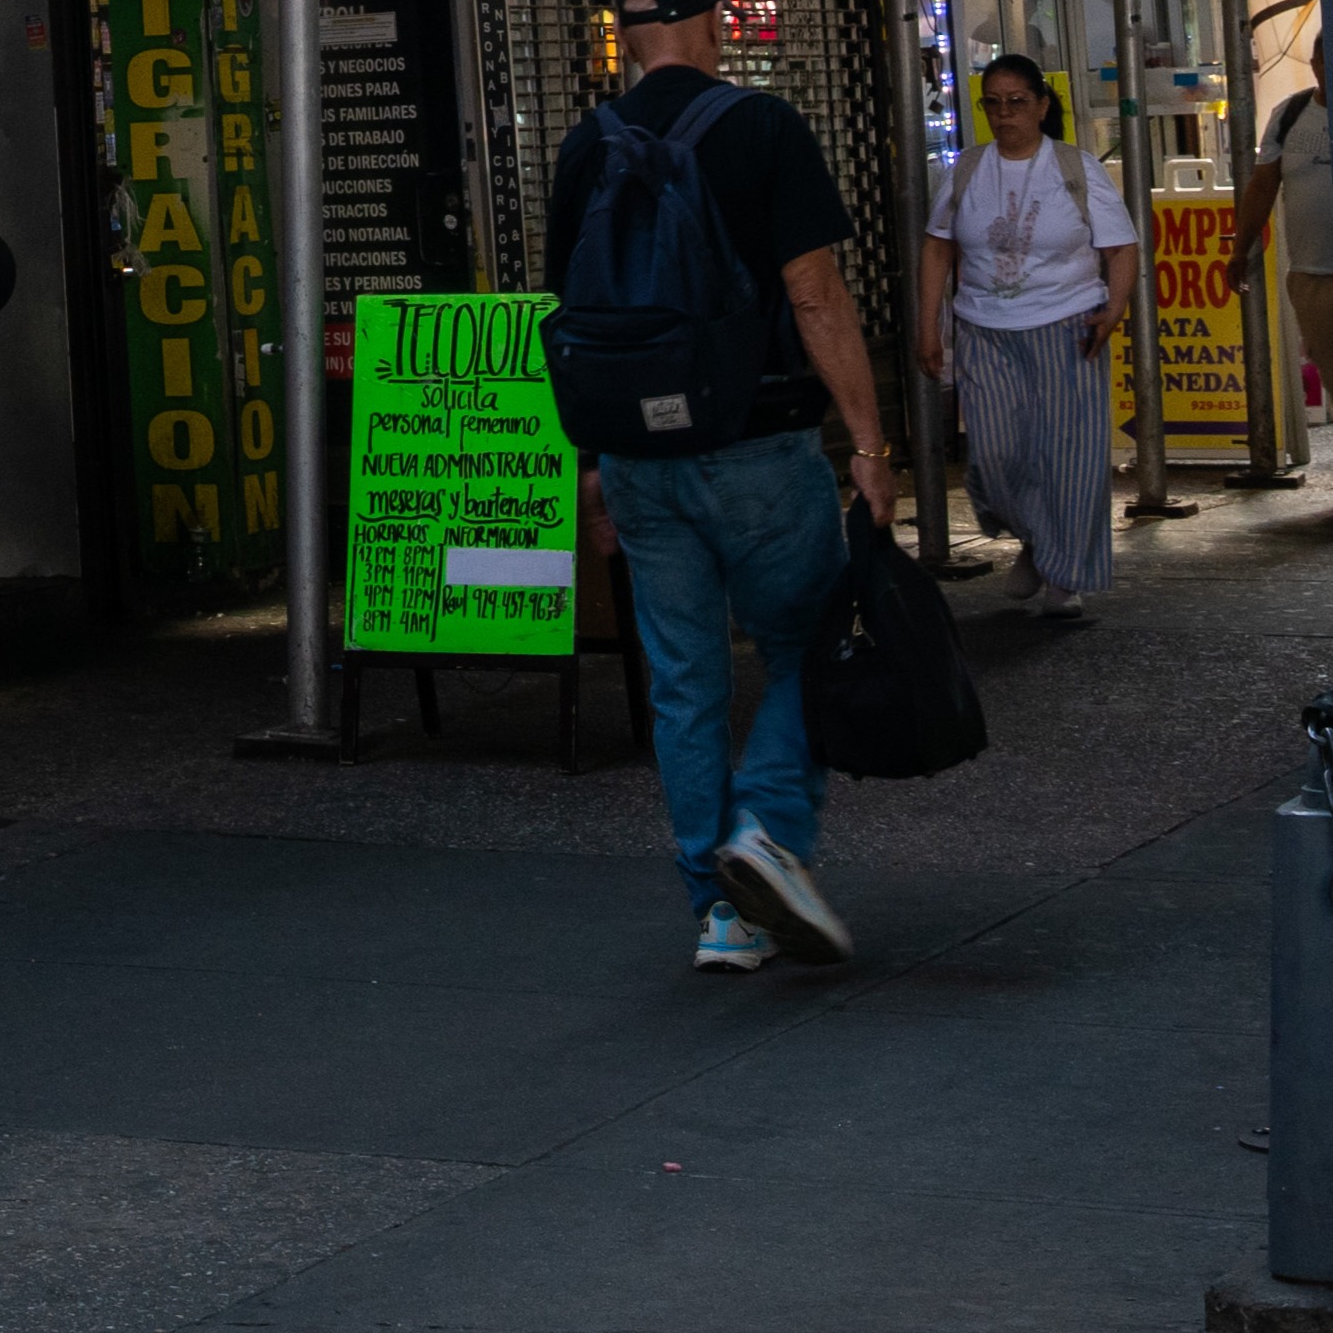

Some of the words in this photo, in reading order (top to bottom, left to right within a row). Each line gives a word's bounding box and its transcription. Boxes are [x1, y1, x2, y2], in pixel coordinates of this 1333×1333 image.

[339, 57, 406, 75] NEGOCIOS
[365, 80, 401, 97] PARA
[339, 105, 418, 123] FAMILIARES
[329, 132, 346, 147] DE
[347, 129, 405, 146] TRABAJO
[329, 156, 347, 171] DE
[348, 149, 420, 170] DIRECCIÓN
[348, 226, 412, 243] NOTARIAL
[354, 275, 423, 292] PERMISOS
[384, 299, 554, 379] TECOLOTE
[1191, 400, 1247, 411] 929-833-
[362, 452, 419, 477] NUEVA
[423, 443, 563, 480] ADMINISTRACIÓN
[354, 523, 431, 545] HORARIOS
[443, 518, 539, 548] INFORMACIÓN
